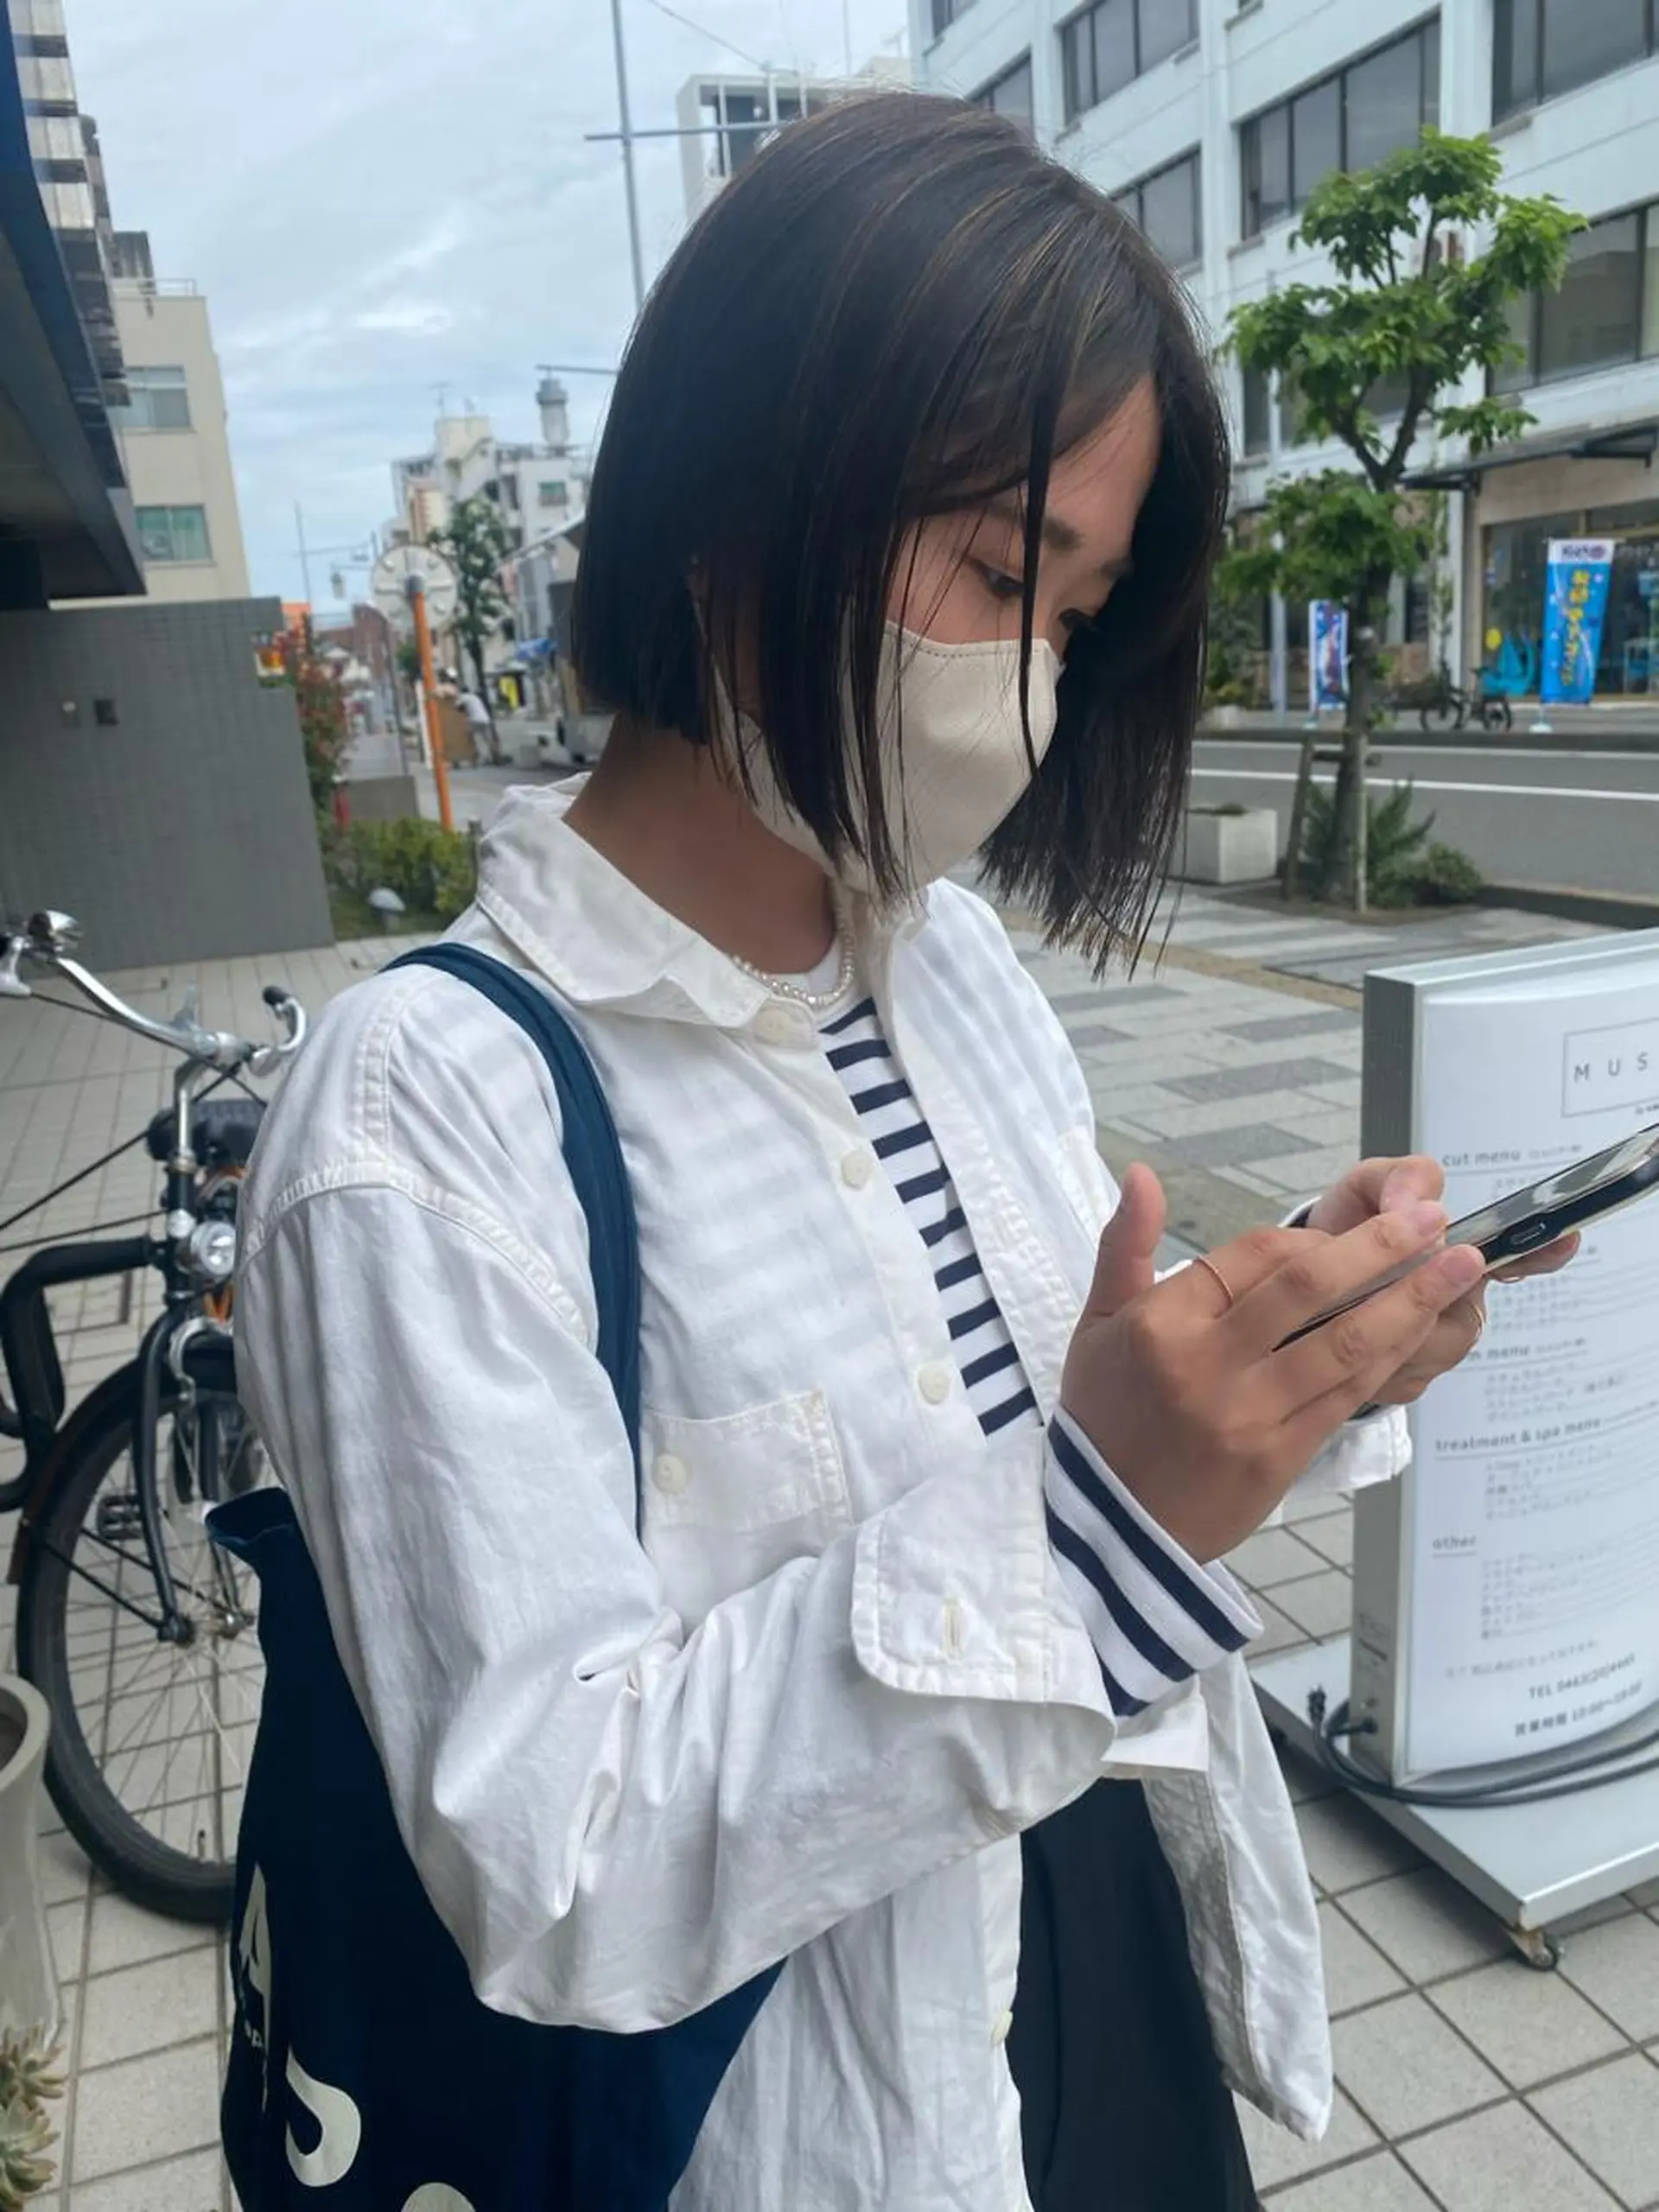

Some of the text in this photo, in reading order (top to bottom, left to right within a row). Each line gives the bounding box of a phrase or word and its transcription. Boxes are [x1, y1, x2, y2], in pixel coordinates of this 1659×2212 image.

[1442, 1153, 1471, 1166] cut
[1474, 1150, 1521, 1165] menu
[1487, 1344, 1530, 1359] menu
[1435, 1417, 1601, 1452] treatment & spa menu
[1433, 1535, 1477, 1549] other
[1529, 1683, 1552, 1699] TEL
